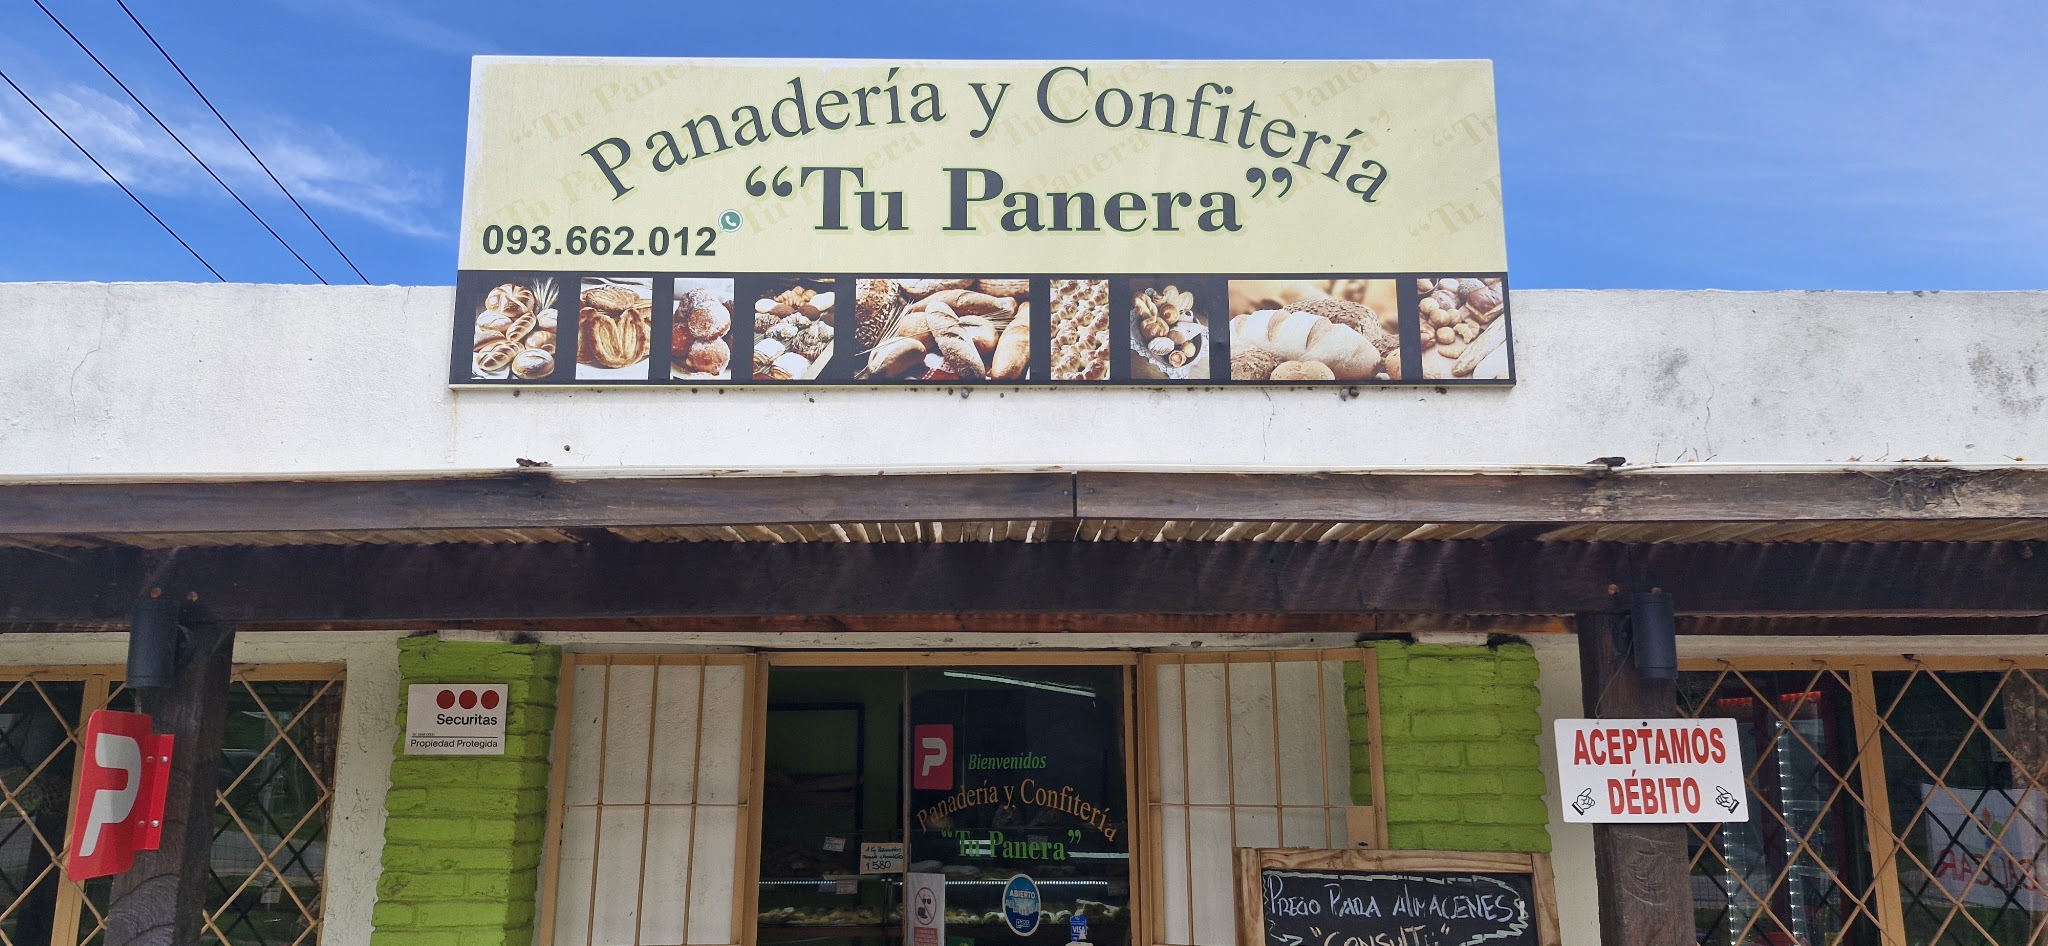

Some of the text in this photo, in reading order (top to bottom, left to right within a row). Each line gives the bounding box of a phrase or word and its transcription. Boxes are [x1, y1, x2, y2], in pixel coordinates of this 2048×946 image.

[582, 67, 946, 201] Panadería
[968, 82, 1010, 138] y
[1036, 66, 1389, 202] Confitería
[745, 166, 909, 232] “Tu
[942, 167, 1293, 232] Panera”
[483, 225, 717, 256] 093.662.012
[436, 713, 498, 726] Securitas
[410, 739, 498, 750] Propiedad Protegida
[968, 752, 1047, 770] Bienvenidos
[1573, 727, 1726, 766] ACEPTAMOS
[1606, 769, 1701, 815] DÉBITO
[917, 778, 1118, 843] Panadería y Confitería
[1009, 889, 1036, 899] ABIERTO
